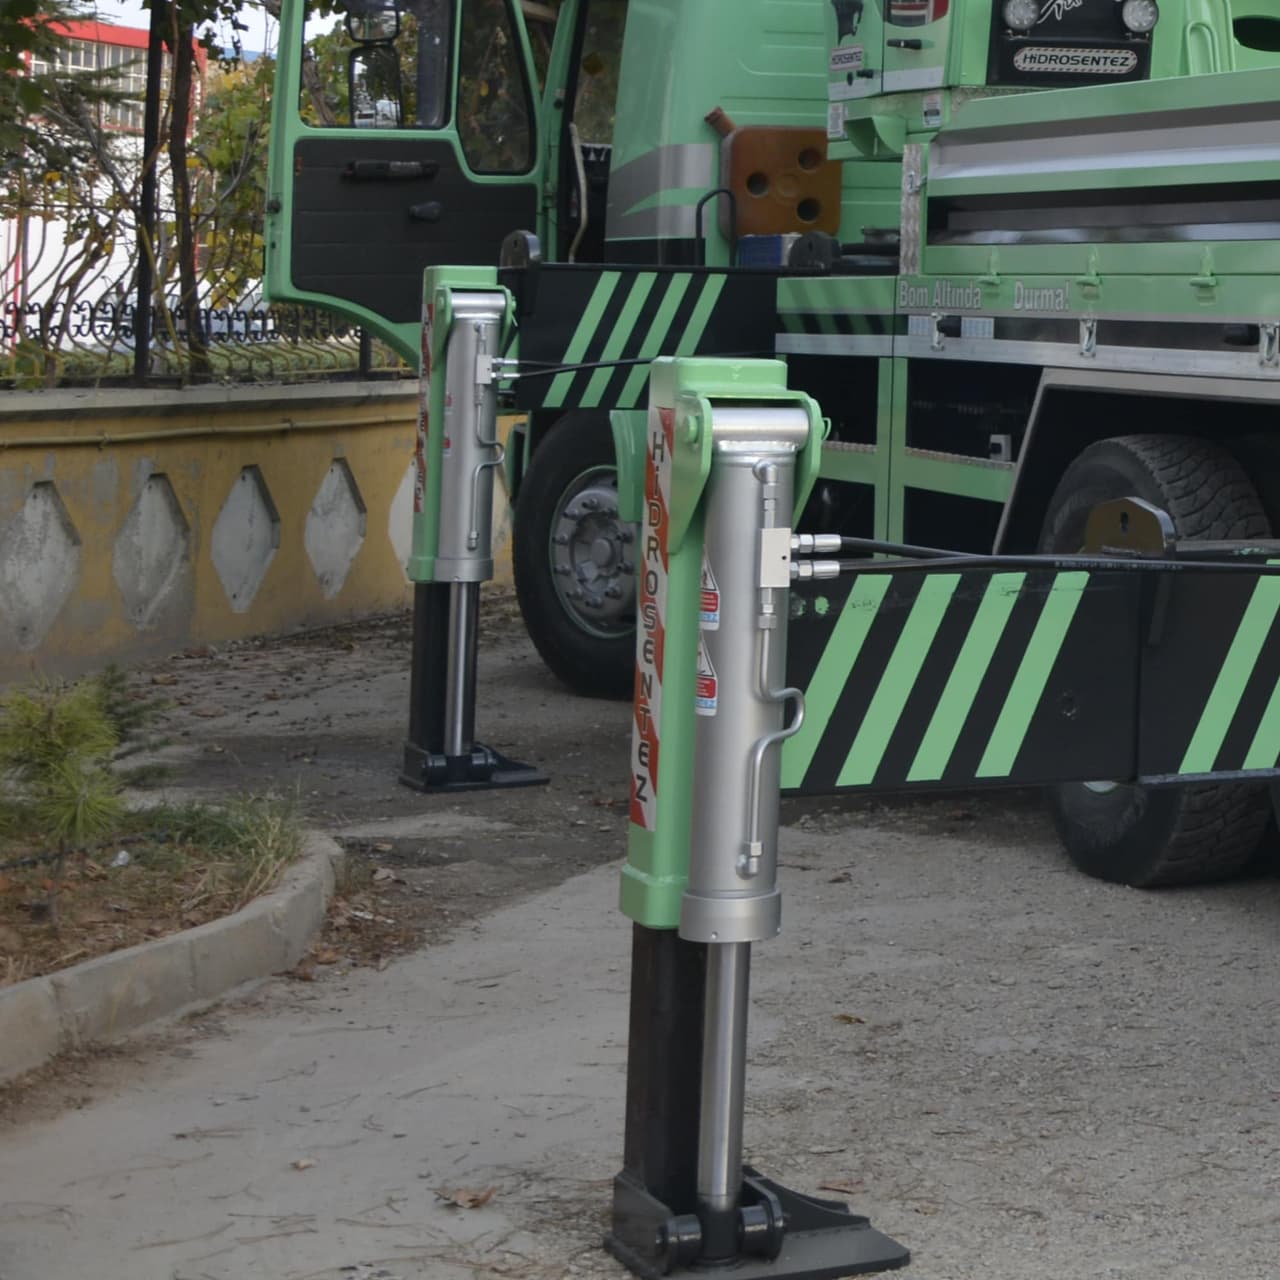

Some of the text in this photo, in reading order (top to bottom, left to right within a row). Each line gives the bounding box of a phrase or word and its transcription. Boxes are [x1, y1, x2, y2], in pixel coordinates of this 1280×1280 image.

[900, 280, 1070, 311] Bom Altında Durma!
